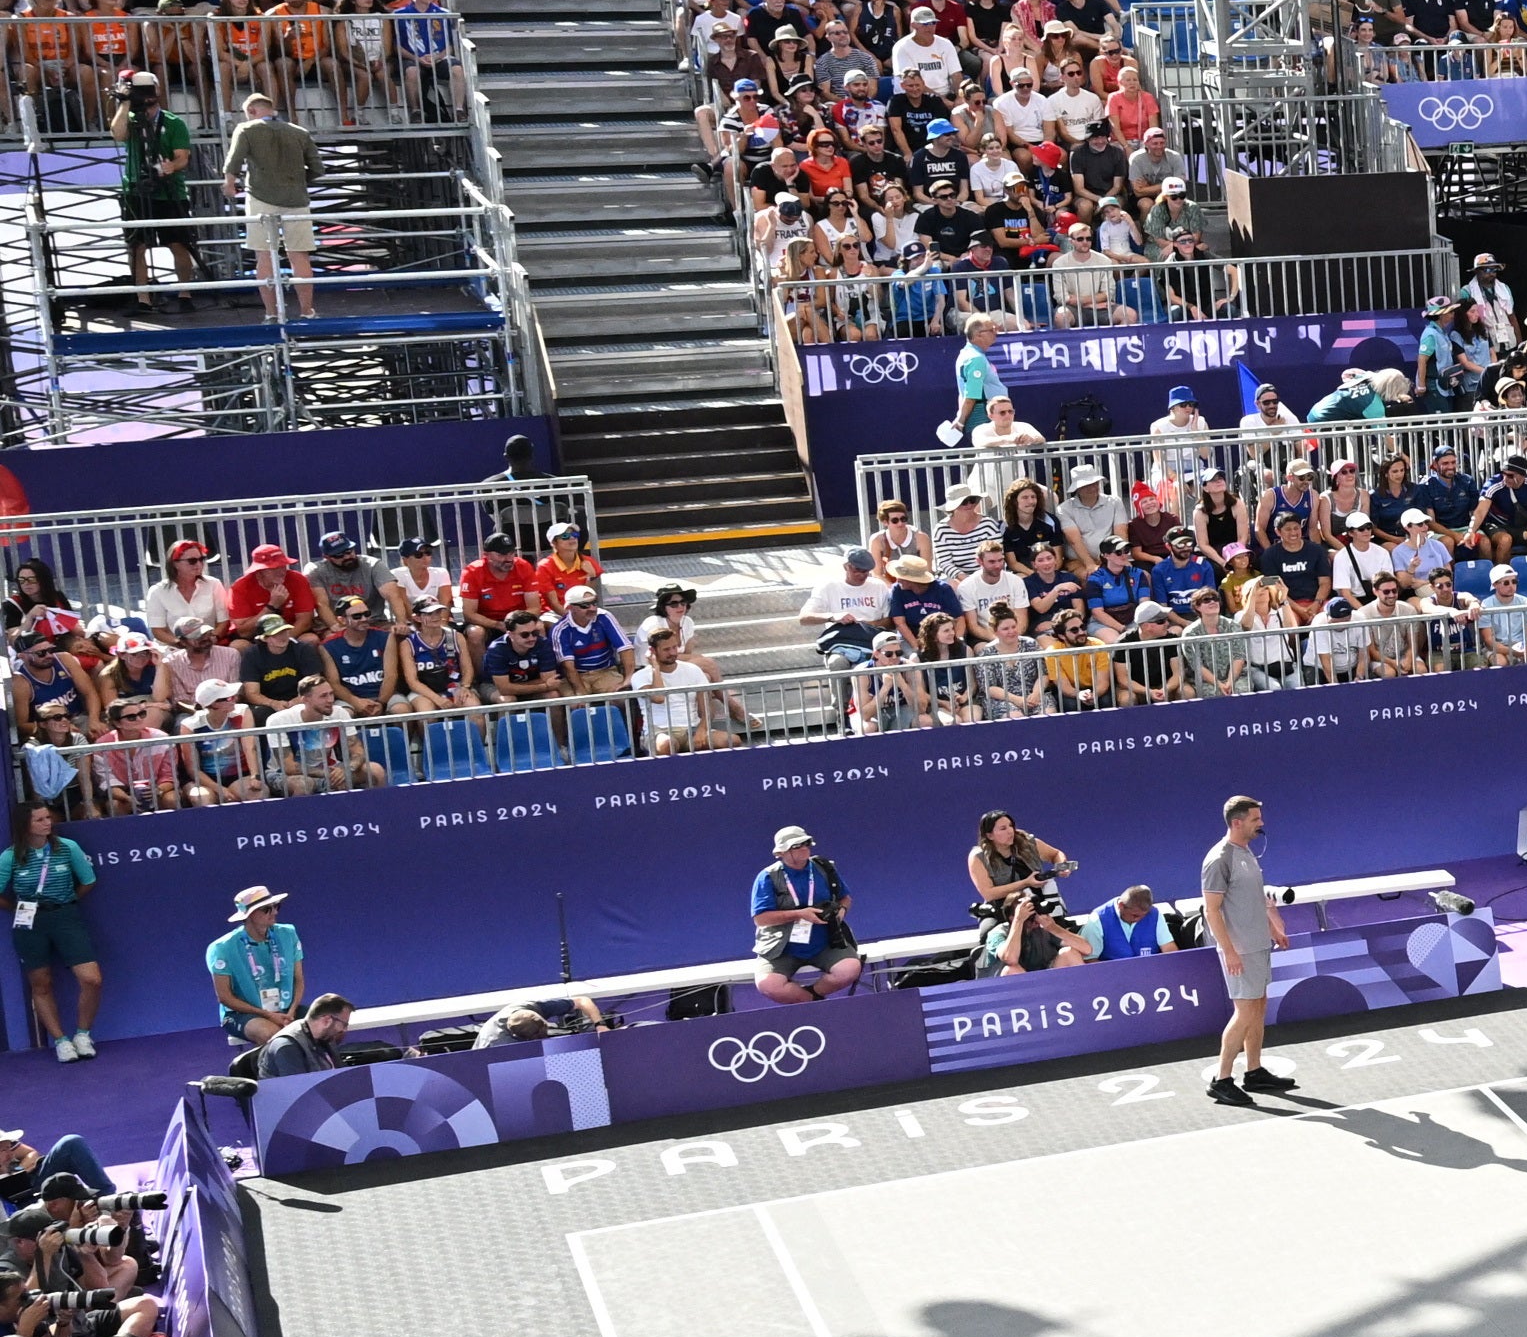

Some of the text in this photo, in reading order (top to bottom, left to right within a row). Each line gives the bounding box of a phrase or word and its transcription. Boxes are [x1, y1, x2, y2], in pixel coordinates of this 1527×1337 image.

[926, 161, 957, 174] FRANCE
[774, 227, 807, 240] FRANCE
[840, 596, 876, 610] FRANCE
[341, 669, 385, 687] FRANC
[1370, 700, 1477, 721] PARIS 2024
[1226, 716, 1340, 738] PARIS 2024
[1078, 731, 1194, 754] PARIS 2024
[923, 747, 1045, 772] PARIS 2024
[762, 765, 889, 791] PARIS 2024
[595, 783, 727, 809] PARIS 2024
[420, 802, 558, 829] PARIS 2024
[237, 822, 380, 850] PARIS 2024
[129, 843, 196, 863] 2024
[952, 984, 1200, 1042] PARIS 2024
[540, 1094, 1032, 1196] PARIS
